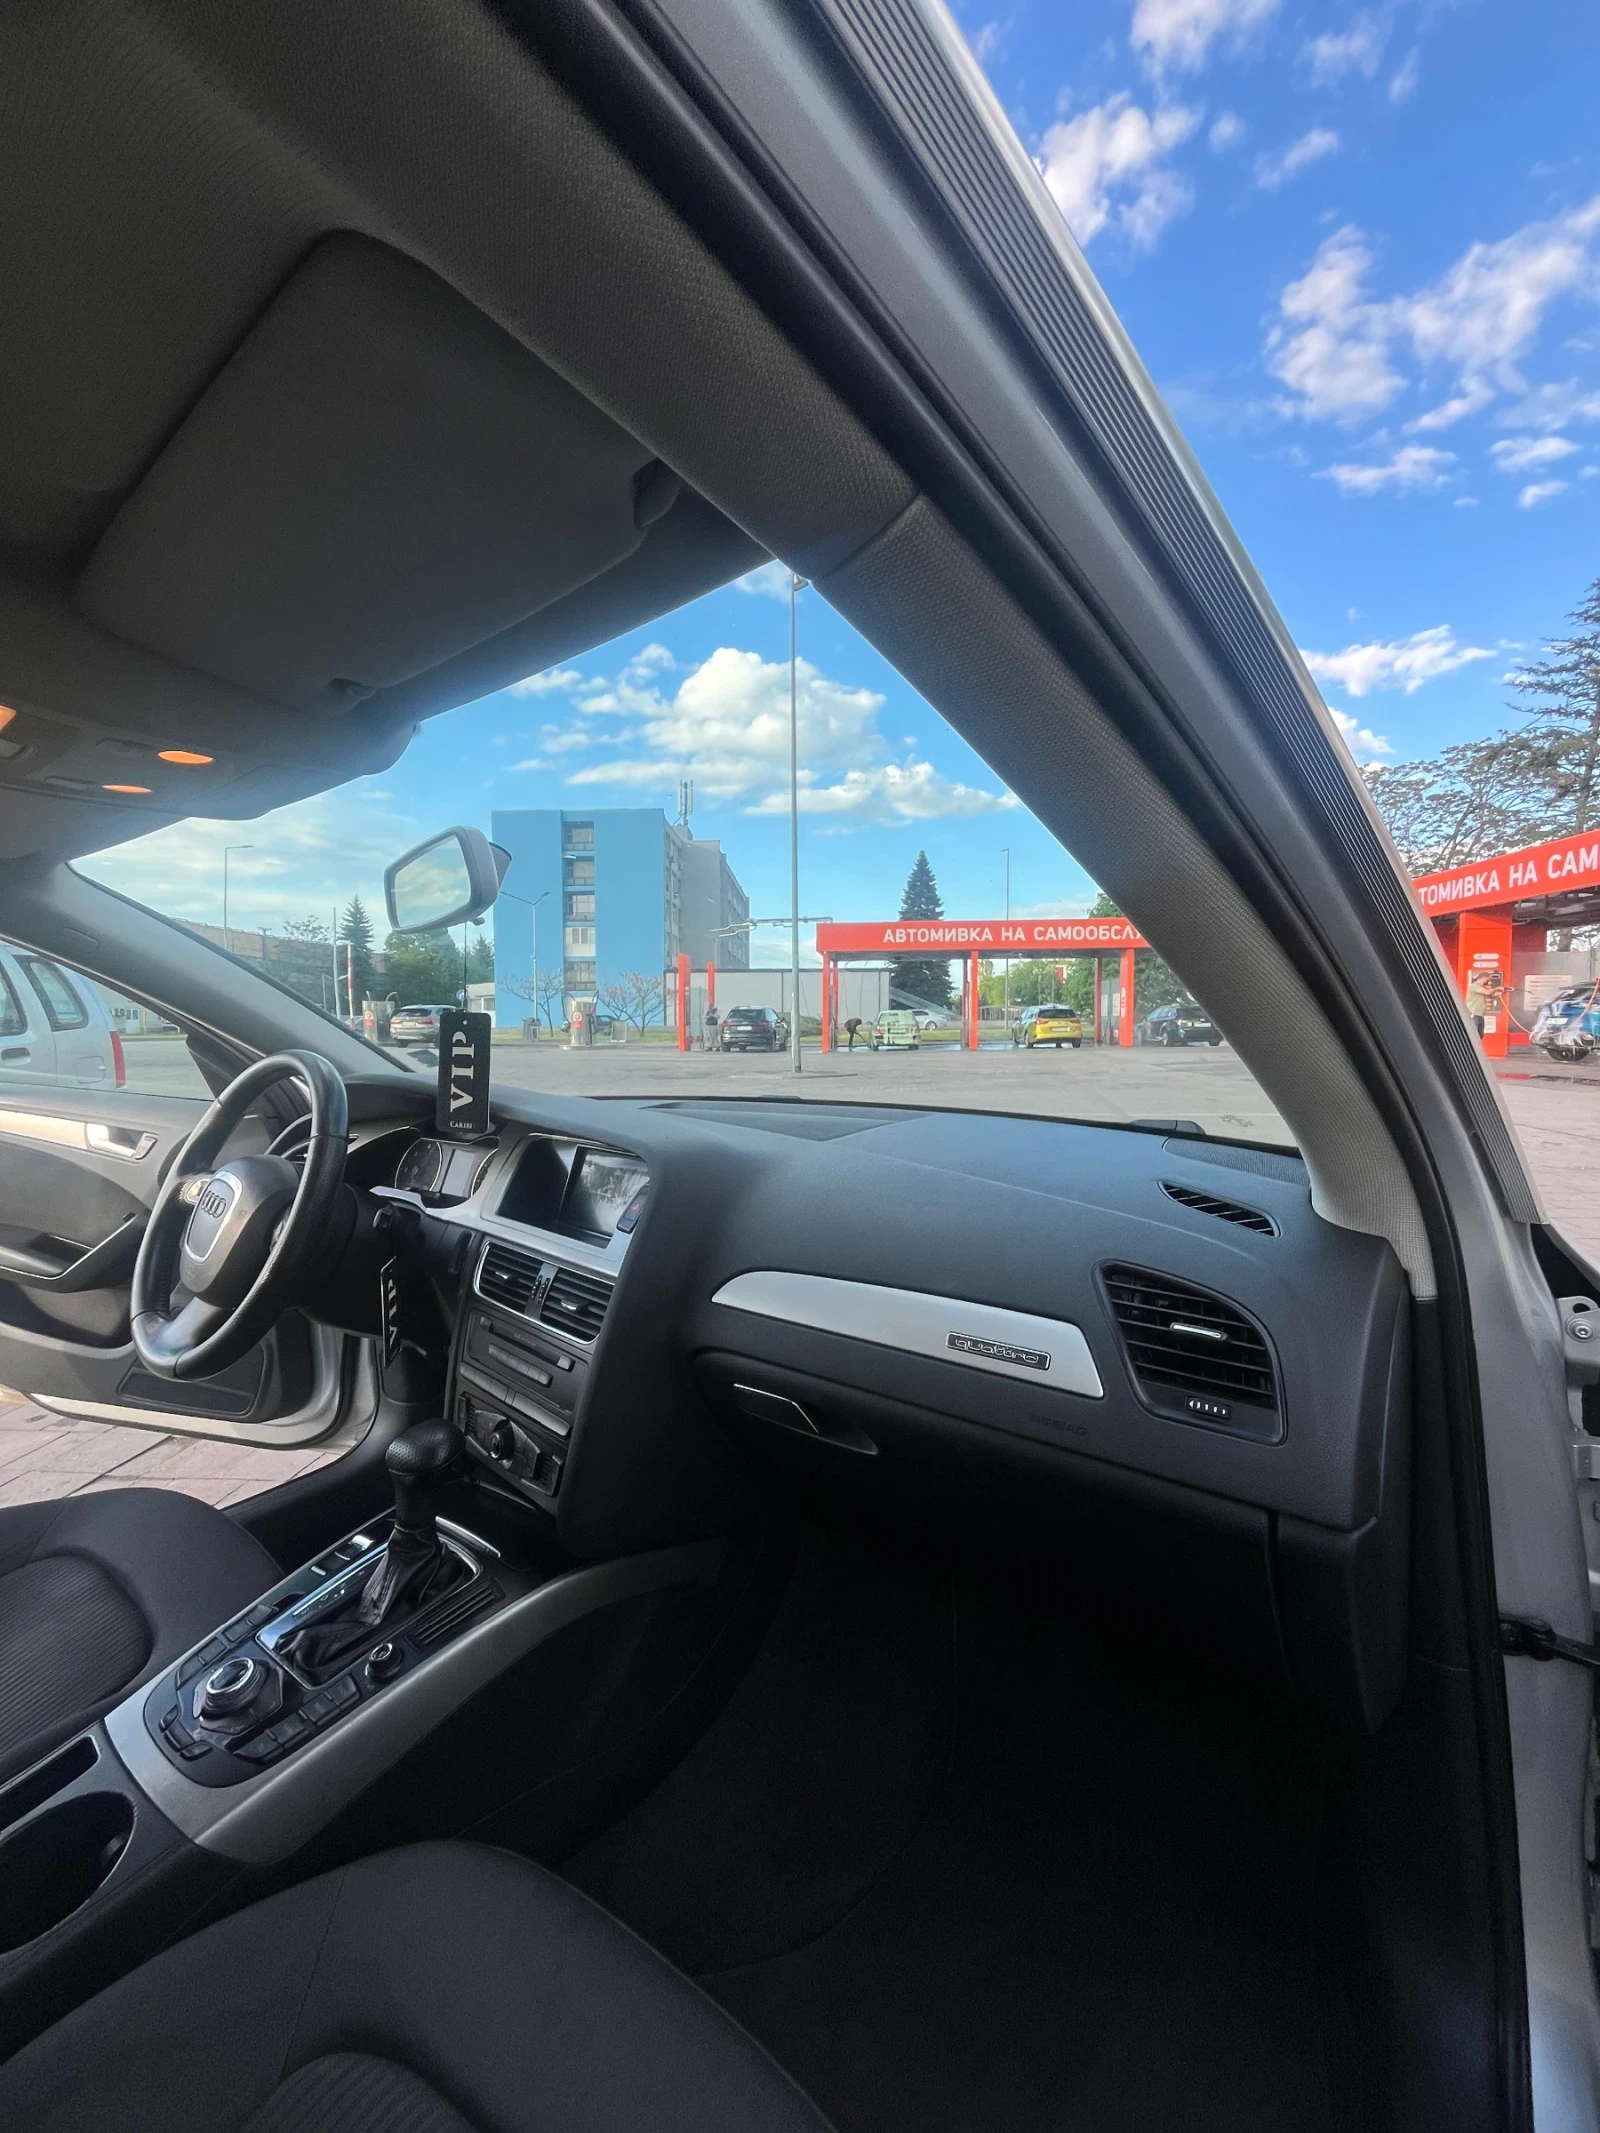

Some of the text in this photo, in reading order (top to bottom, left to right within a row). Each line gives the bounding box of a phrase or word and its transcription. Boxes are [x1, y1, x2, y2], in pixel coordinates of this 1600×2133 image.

[1509, 860, 1537, 888] НА
[1547, 844, 1599, 879] САМ
[883, 928, 993, 943] АВТОМИВКА
[1001, 926, 1026, 942] НА
[450, 1031, 475, 1112] VIP
[955, 1338, 1039, 1363] quattro
